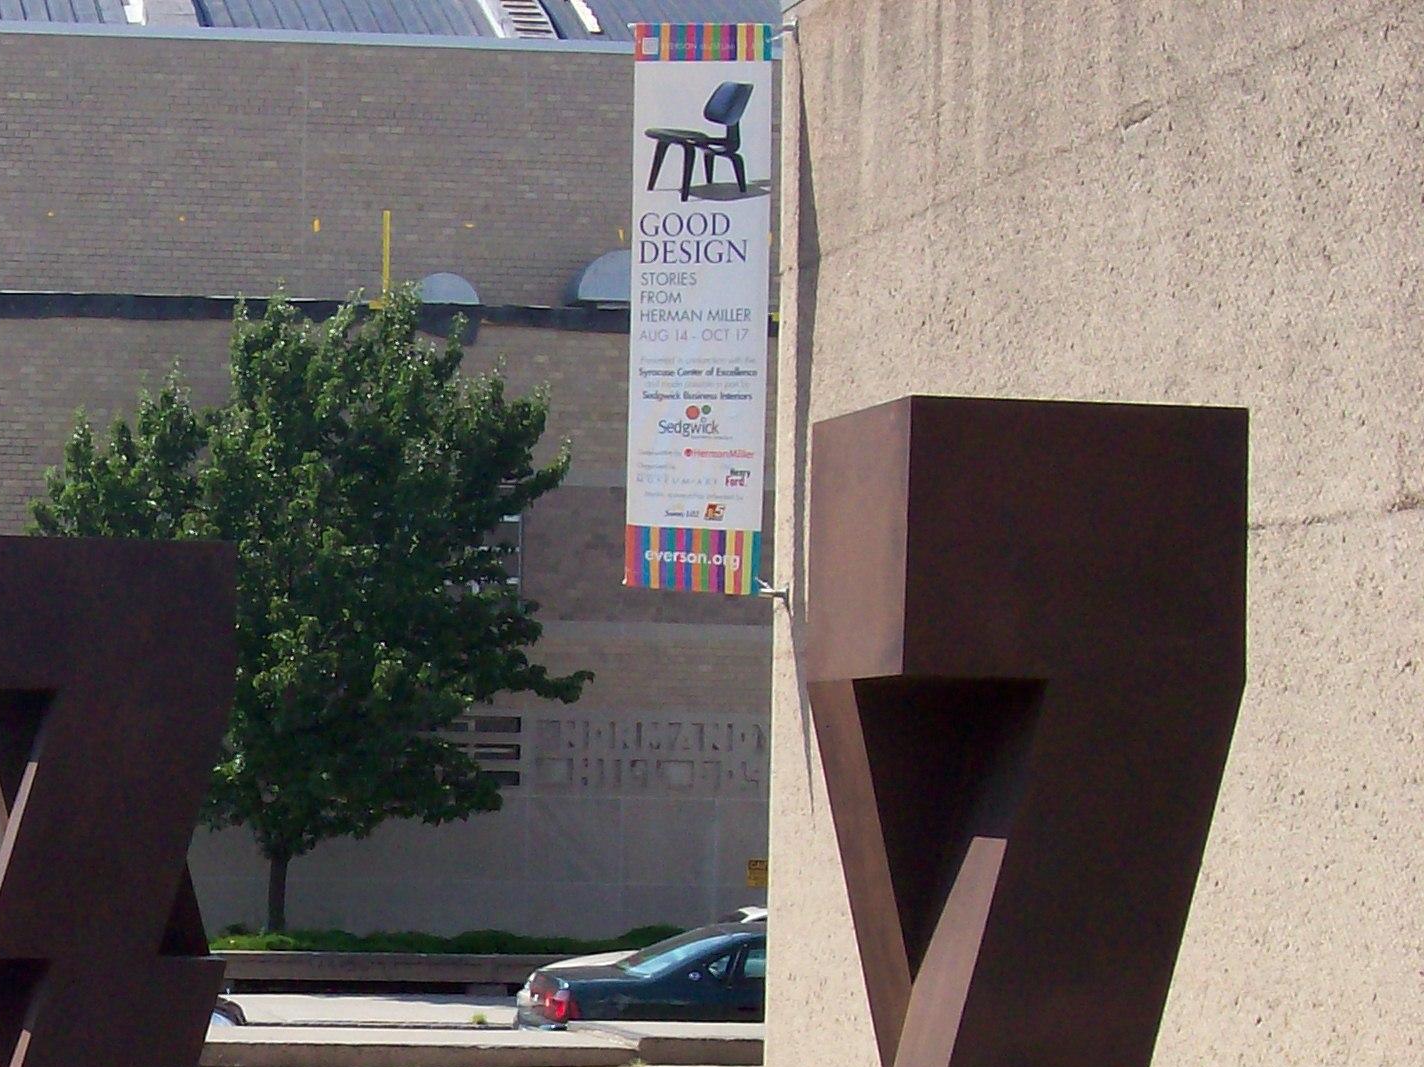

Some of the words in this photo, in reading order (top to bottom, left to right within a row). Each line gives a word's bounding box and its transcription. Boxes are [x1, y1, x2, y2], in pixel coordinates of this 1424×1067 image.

[639, 212, 730, 237] GOOD
[639, 239, 748, 264] DESIGN
[640, 272, 697, 286] STORIES
[640, 290, 682, 304] FROM
[640, 309, 702, 323] HERMAN
[707, 308, 752, 322] MILLER
[639, 329, 669, 342] AUG
[676, 328, 688, 341] 14
[701, 328, 729, 341] OCT
[736, 328, 749, 341] 17
[677, 367, 703, 377] Center
[705, 367, 714, 376] of
[642, 390, 681, 401] Sedgwick
[658, 418, 719, 437] Sedgwick
[725, 475, 746, 487] Ford
[644, 549, 741, 571] everson.org
